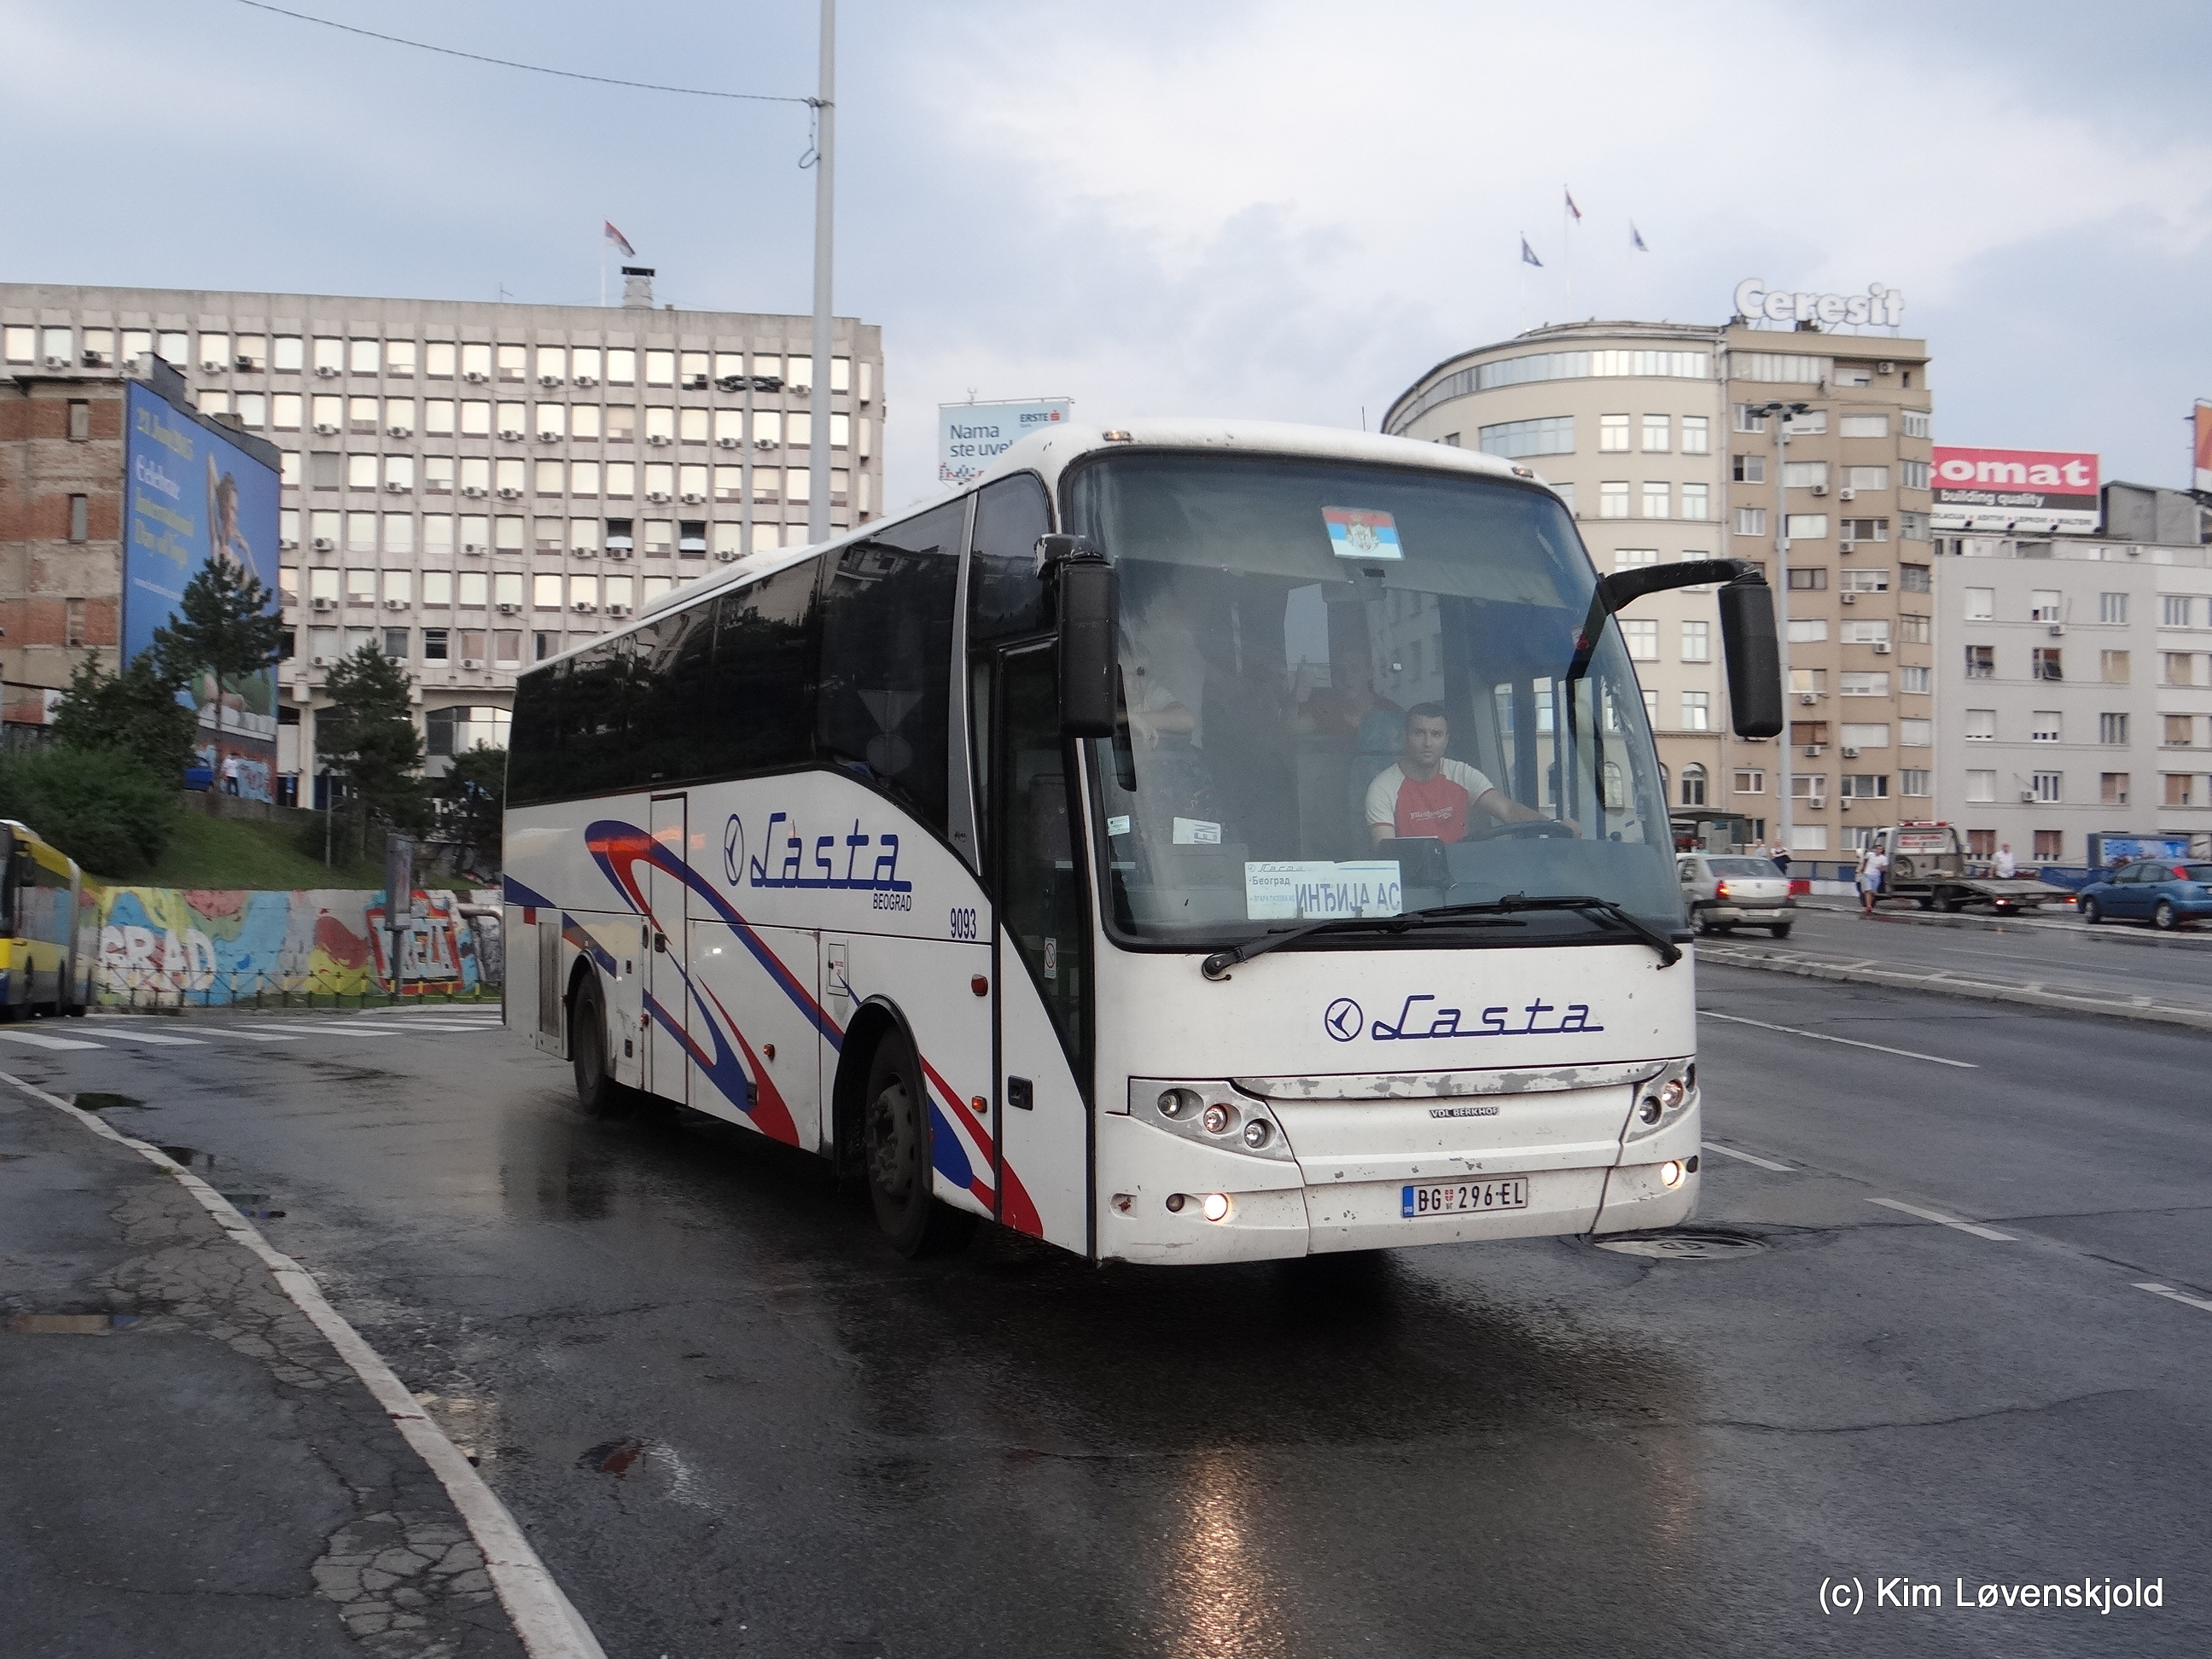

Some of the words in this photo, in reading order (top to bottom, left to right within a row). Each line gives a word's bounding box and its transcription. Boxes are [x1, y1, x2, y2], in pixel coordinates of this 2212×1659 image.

[1735, 277, 1904, 327] Ceresit
[1020, 412, 1048, 422] ERSTE
[950, 424, 999, 439] Nama
[950, 443, 975, 457] ste
[979, 439, 1013, 457] uve
[1941, 490, 1996, 505] building
[1997, 493, 2045, 507] quality
[750, 812, 912, 893] Lasta
[1252, 876, 1290, 886] Београд
[873, 893, 911, 911] BEOGRAD
[1295, 882, 1371, 912] ИНЂИЈА
[1377, 882, 1400, 911] АС
[951, 908, 976, 940] 9093
[1371, 995, 1604, 1040] Lasta
[1430, 1109, 1451, 1119] VDL
[1452, 1107, 1499, 1117] BERKHOF
[1418, 1189, 1441, 1211] BG
[1458, 1183, 1522, 1208] 296-EL
